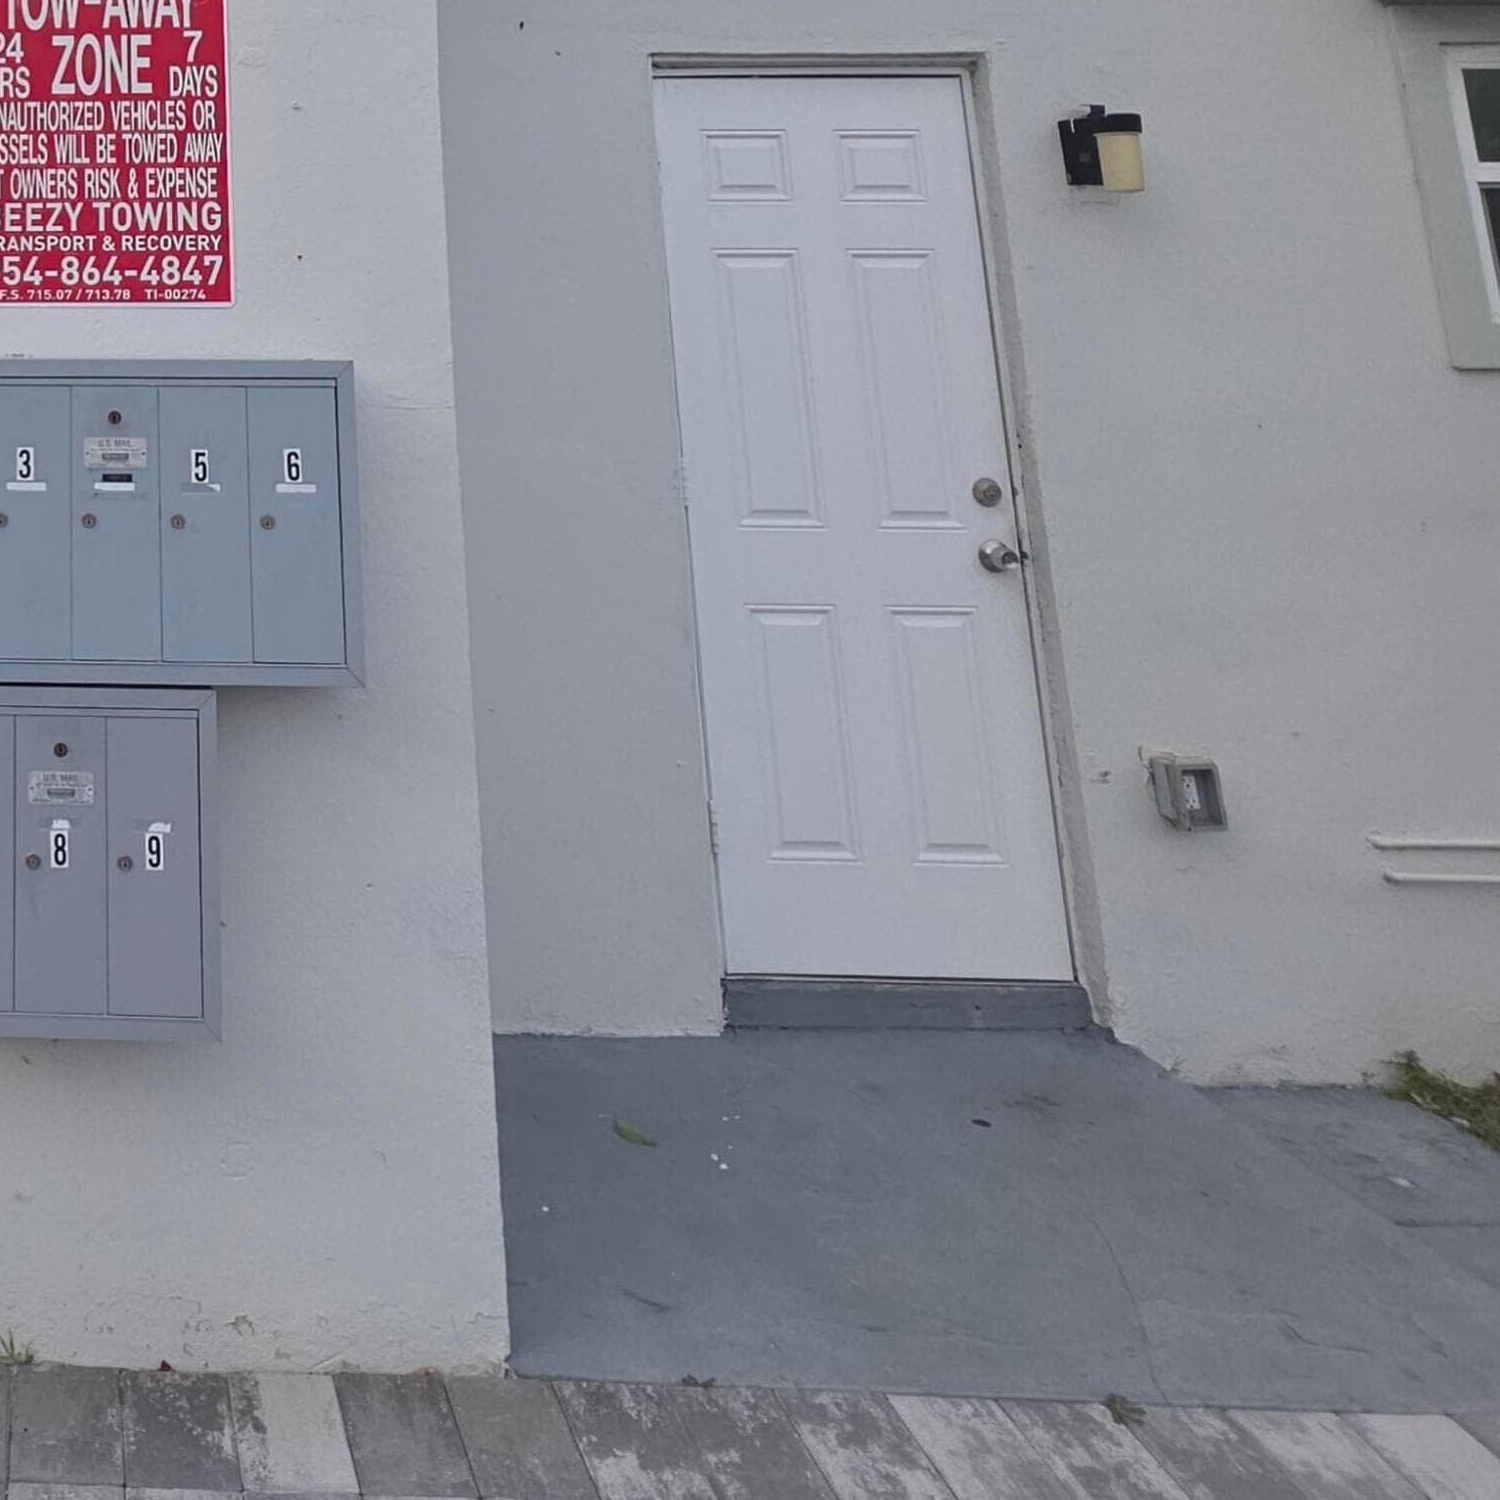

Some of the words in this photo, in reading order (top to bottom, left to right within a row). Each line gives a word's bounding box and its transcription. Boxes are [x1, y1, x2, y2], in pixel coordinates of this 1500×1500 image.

[183, 31, 203, 62] 7
[52, 34, 153, 95] ZONE
[169, 66, 218, 97] DAYS
[111, 101, 187, 131] VEHICLES
[192, 100, 216, 130] OR
[54, 134, 90, 164] WILL
[96, 134, 116, 164] BE
[122, 133, 178, 164] TOWED
[184, 133, 223, 163] AWAY
[10, 170, 78, 199] OWNERS
[84, 169, 121, 199] RISK
[128, 170, 139, 199] &
[146, 168, 218, 198] EXPENSE
[92, 202, 222, 232] TOWING
[102, 236, 115, 251] &
[122, 235, 223, 251] RECOVERY
[0, 289, 23, 300] F.S.
[28, 289, 72, 300] 715.07
[85, 289, 131, 300] 713.78
[145, 289, 206, 300] TI-00274
[18, 449, 31, 478] 3
[194, 452, 207, 482] 5
[287, 451, 300, 480] 6
[54, 833, 66, 865] 8
[148, 836, 161, 868] 9
